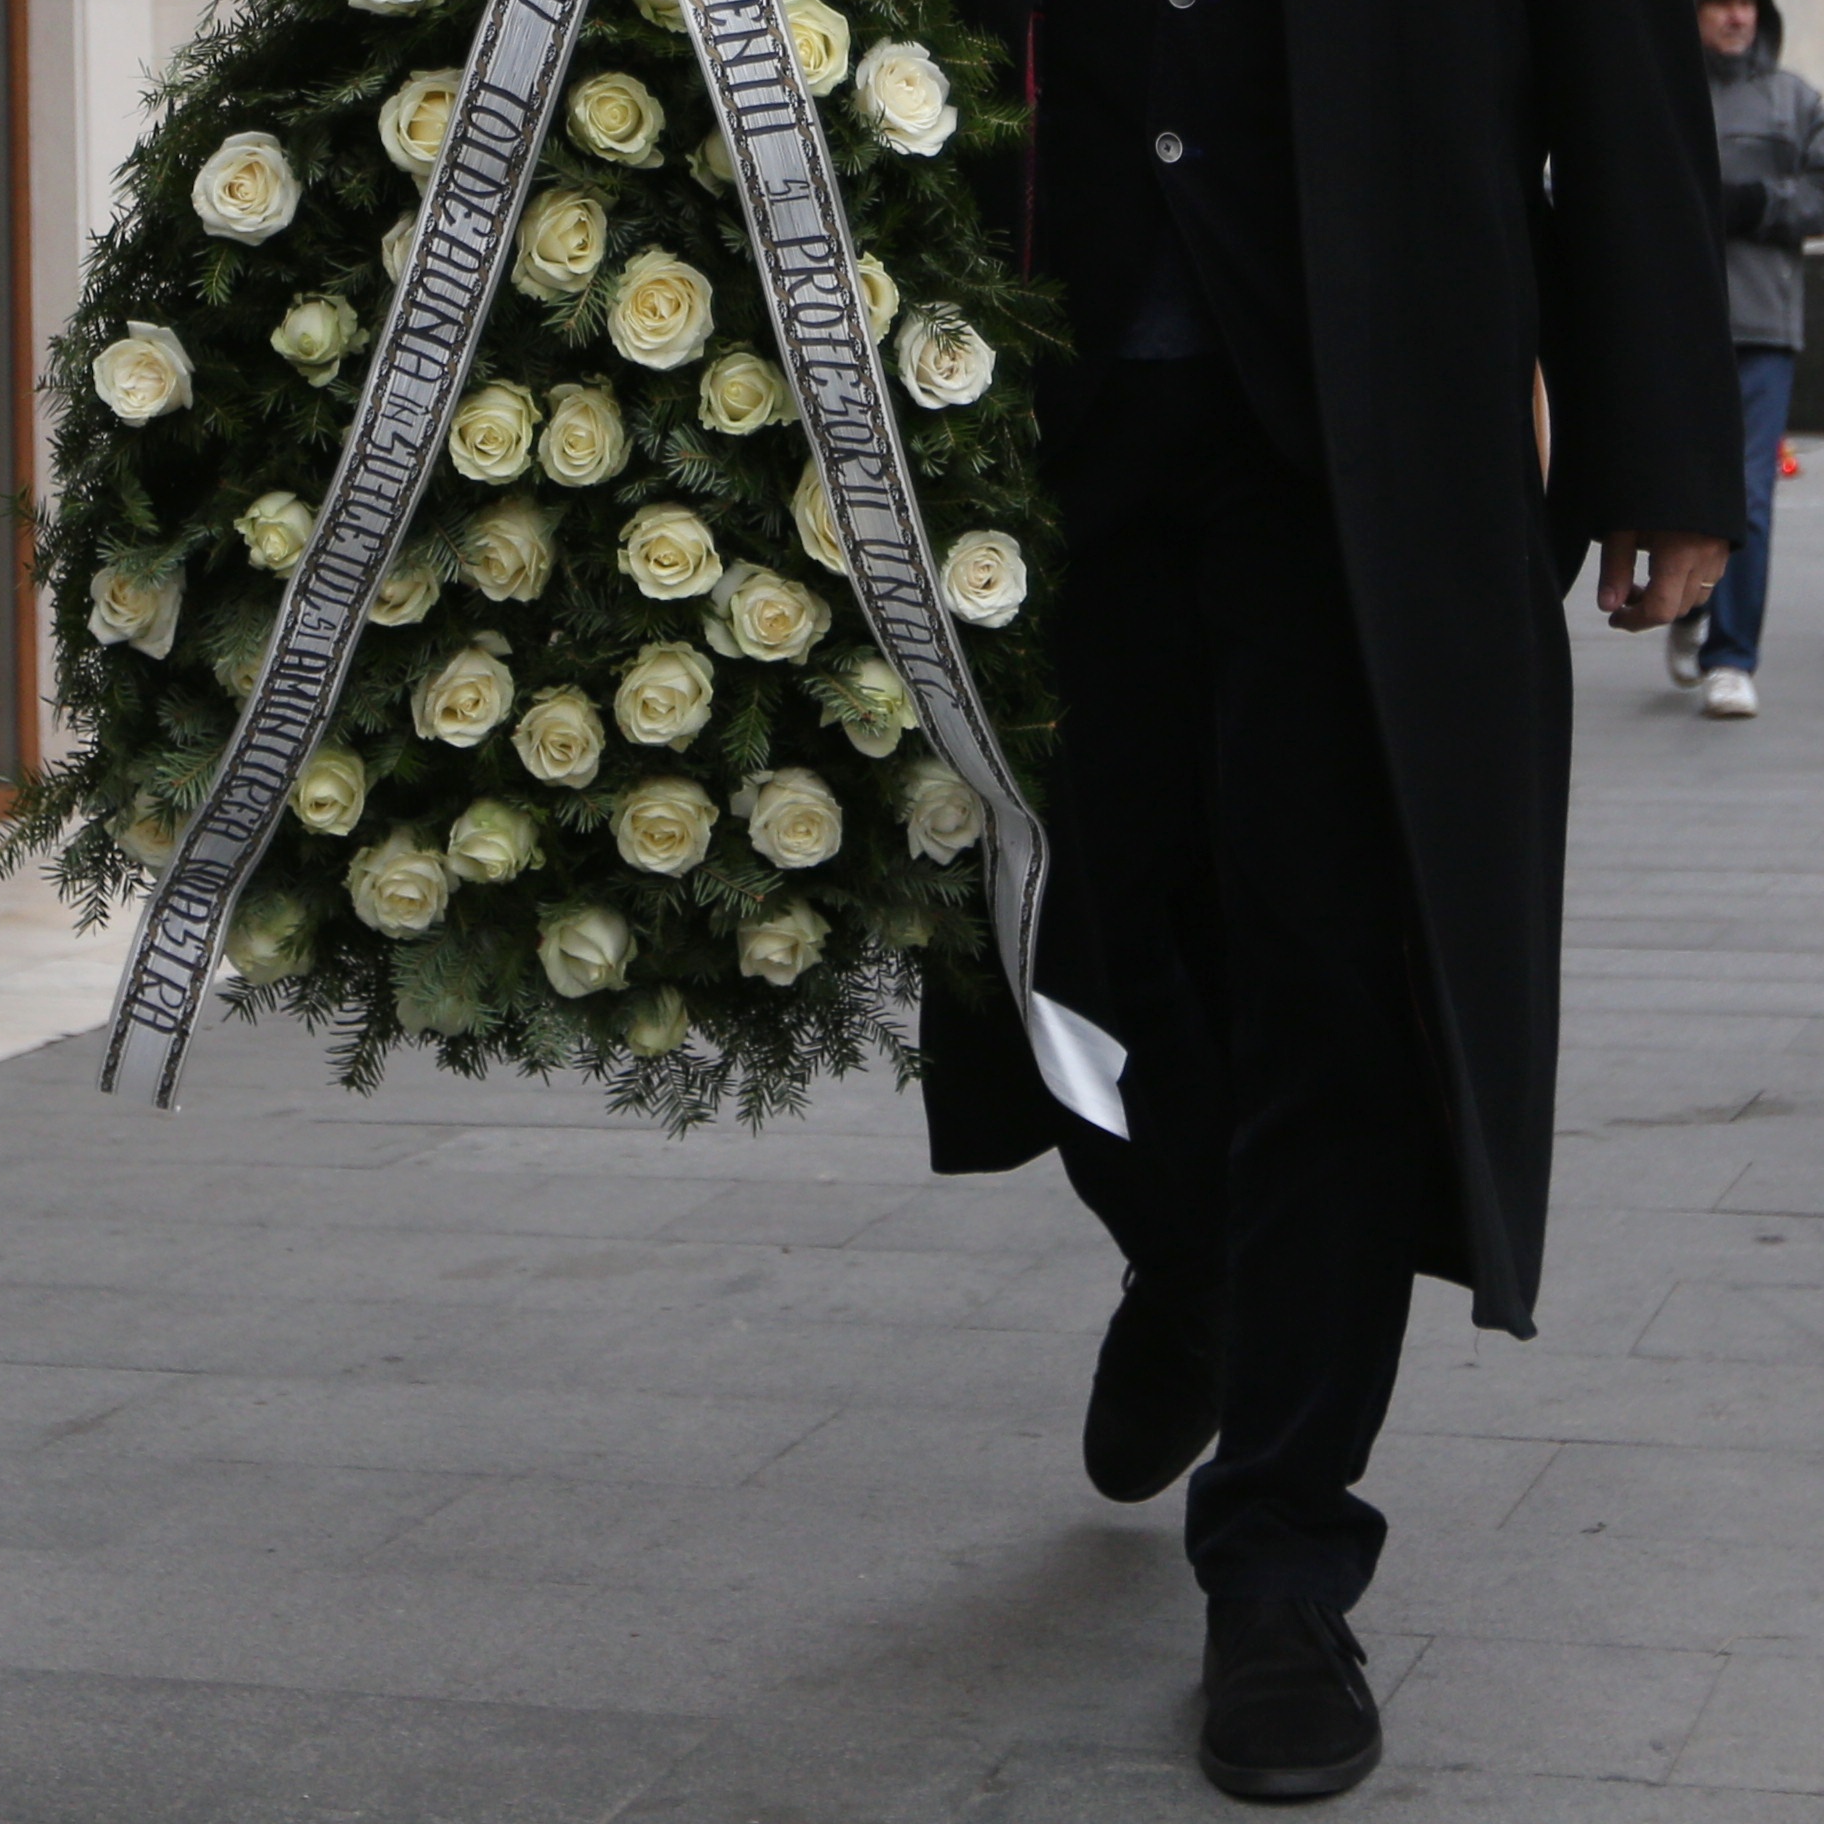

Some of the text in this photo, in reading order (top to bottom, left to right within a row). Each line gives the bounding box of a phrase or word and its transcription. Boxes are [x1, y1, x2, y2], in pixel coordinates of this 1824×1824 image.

[387, 79, 535, 383] TOTDEAUNA
[773, 235, 893, 511] PROFESORII
[301, 431, 423, 611] SUFLETUL
[202, 648, 333, 844] AMINTIREA
